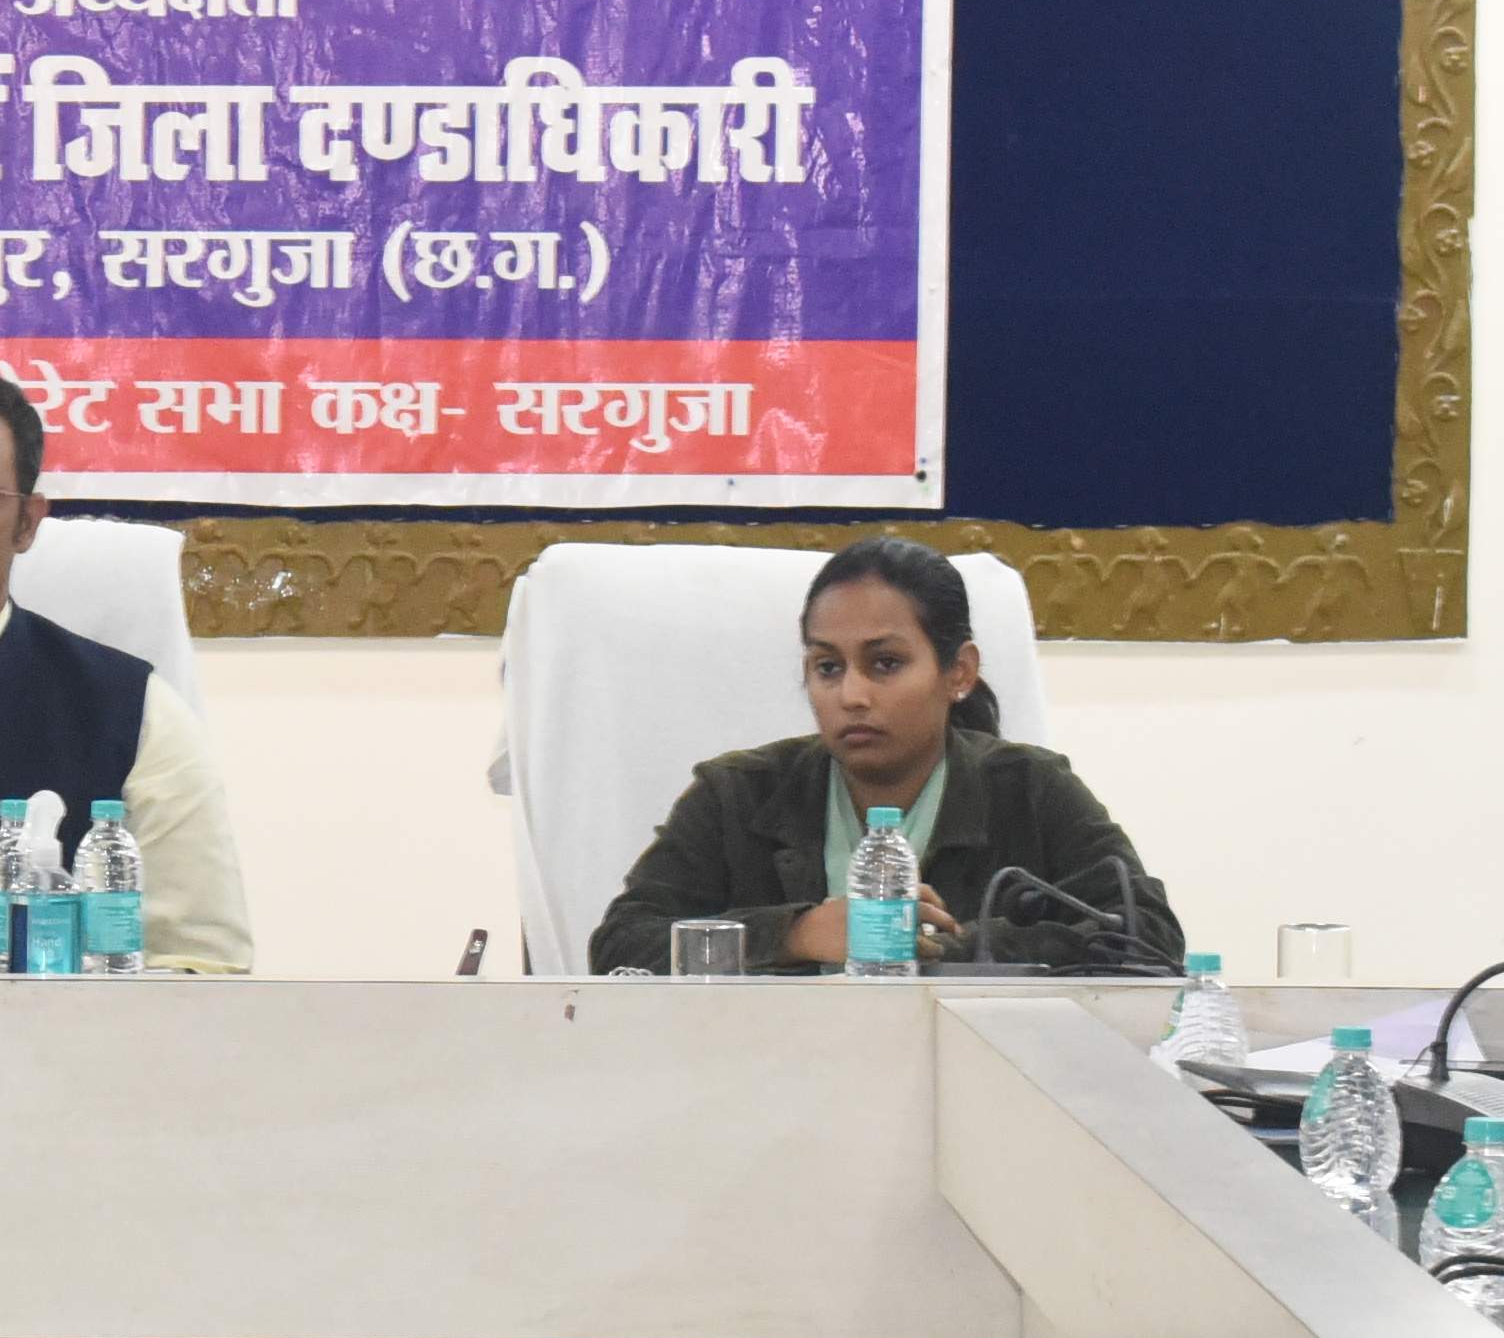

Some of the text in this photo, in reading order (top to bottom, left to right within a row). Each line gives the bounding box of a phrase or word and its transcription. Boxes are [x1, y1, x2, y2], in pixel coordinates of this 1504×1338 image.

[25, 54, 278, 183] जिला
[288, 56, 816, 184] दण्डाधिकारी
[99, 229, 358, 308] सरगुजा
[382, 219, 612, 304] (छ.ग.)
[136, 380, 284, 434] सभा
[308, 380, 467, 436] कक्ष-
[496, 382, 753, 453] सरगुजा
